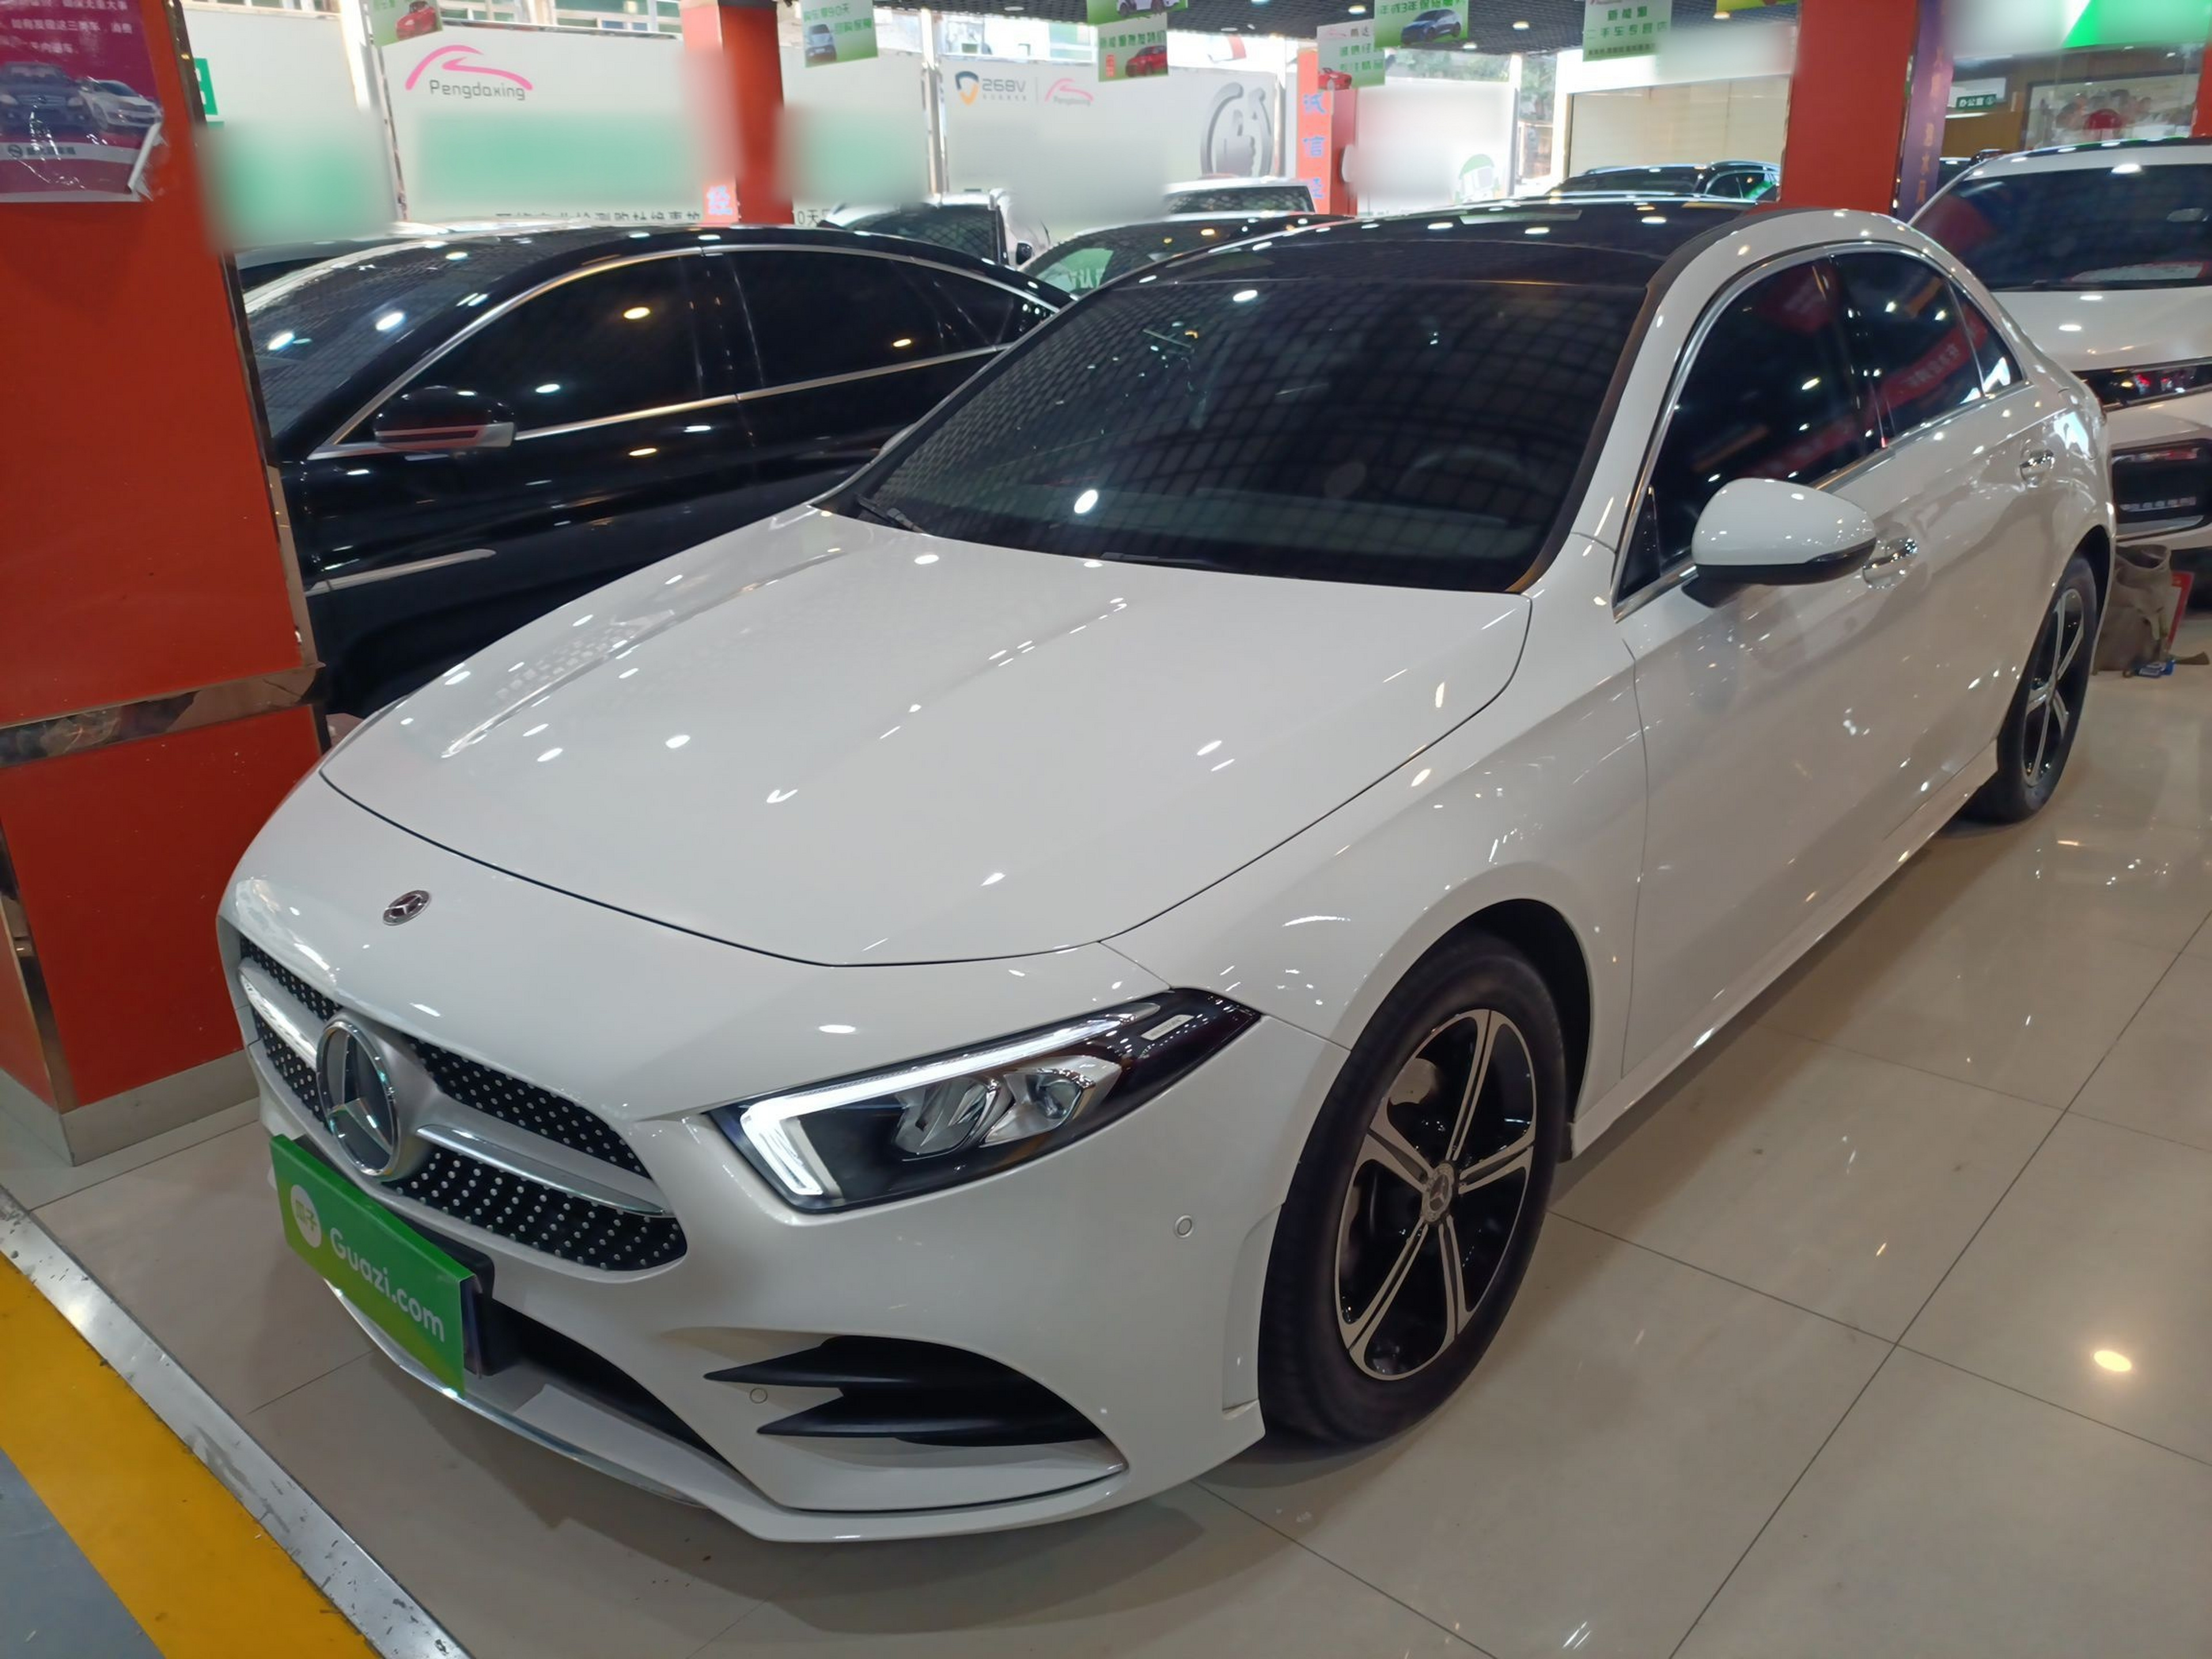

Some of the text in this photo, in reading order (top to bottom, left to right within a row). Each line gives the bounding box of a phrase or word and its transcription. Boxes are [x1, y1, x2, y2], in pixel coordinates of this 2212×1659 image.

[429, 79, 525, 101] Pengdaxing
[982, 78, 1026, 93] 268V
[329, 1227, 445, 1343] Guazi.com
